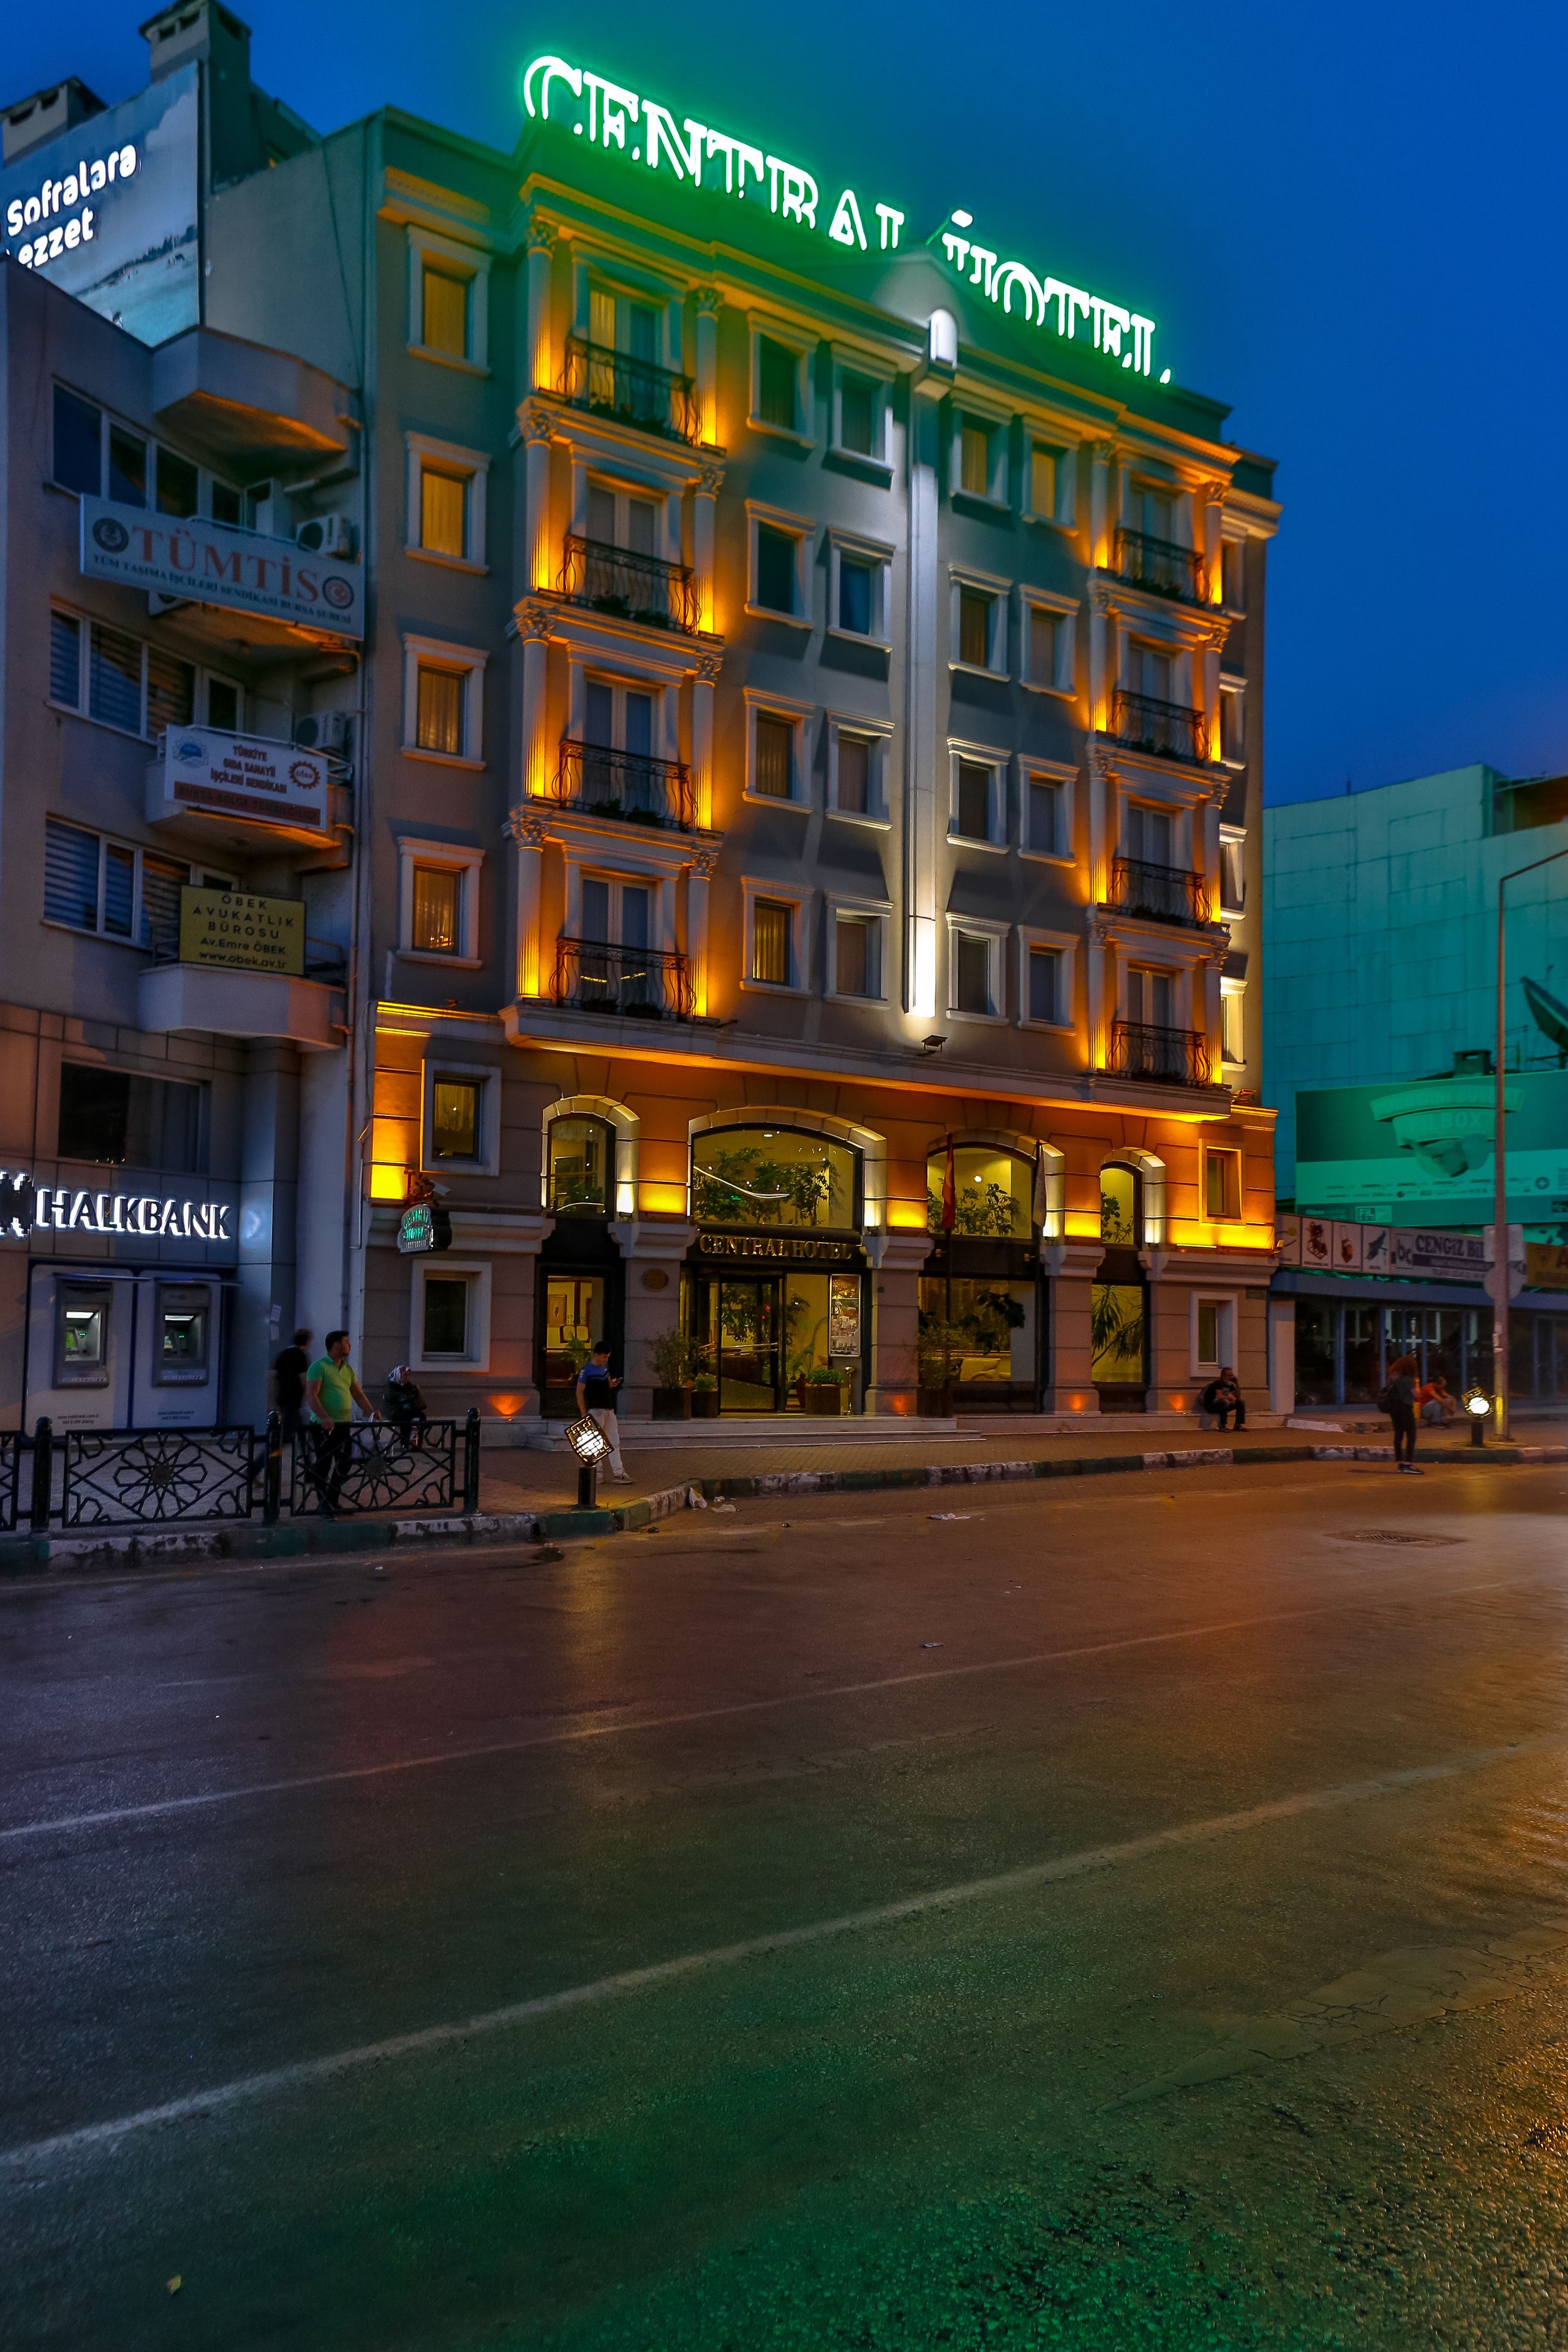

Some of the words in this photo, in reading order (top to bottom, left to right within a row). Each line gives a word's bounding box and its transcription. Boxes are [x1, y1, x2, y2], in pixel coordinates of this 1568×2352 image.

[7, 144, 137, 236] Sofralara
[6, 206, 94, 269] ezzet
[192, 905, 294, 927] AVUKATLIK
[208, 921, 279, 940] BÜROSU
[199, 951, 287, 970] www.obek.av.tr
[36, 1188, 232, 1239] HALKBANK
[699, 1235, 789, 1256] CENTRAL
[792, 1240, 853, 1259] HOTEL
